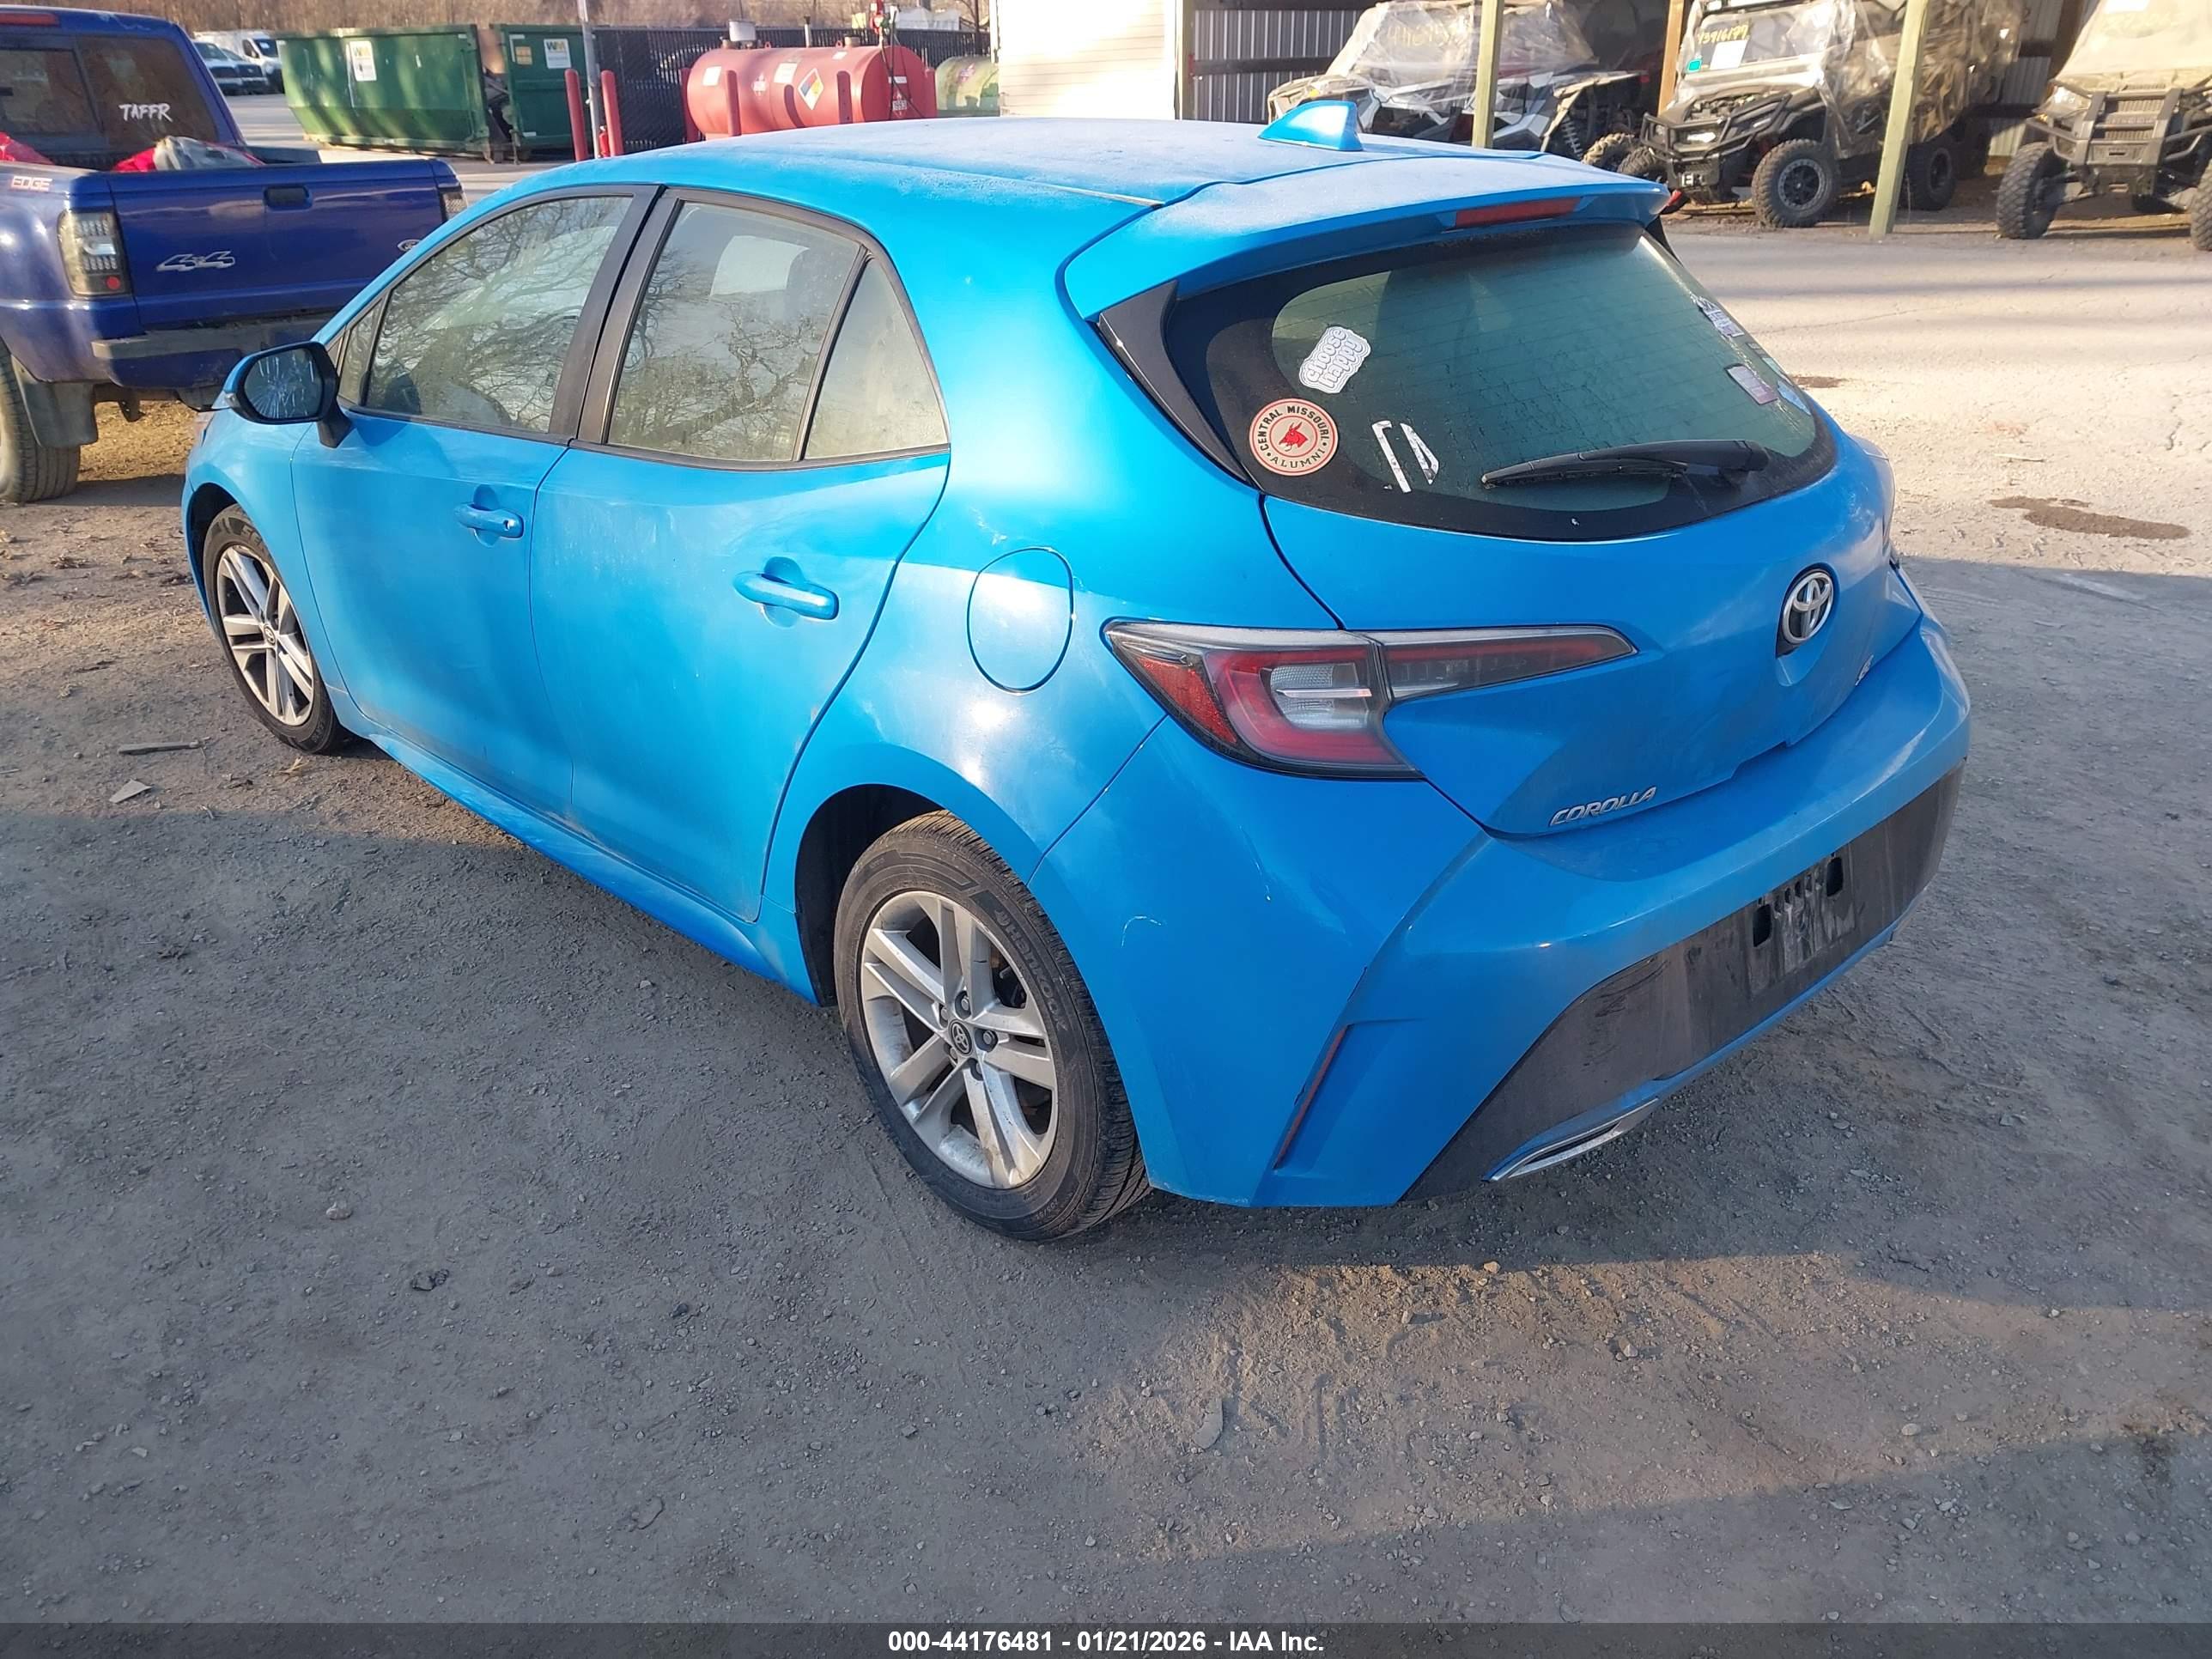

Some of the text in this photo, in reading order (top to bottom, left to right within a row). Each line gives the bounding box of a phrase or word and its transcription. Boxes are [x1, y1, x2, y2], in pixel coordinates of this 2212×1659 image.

[118, 102, 173, 122] TAFFR
[11, 175, 53, 191] EDGE
[1305, 329, 1346, 383] choose
[1318, 337, 1364, 389] happy
[1256, 404, 1330, 452] CENTRAL MISSOURI
[1269, 447, 1326, 469] ALUMNI
[1549, 786, 1657, 827] COROLLA
